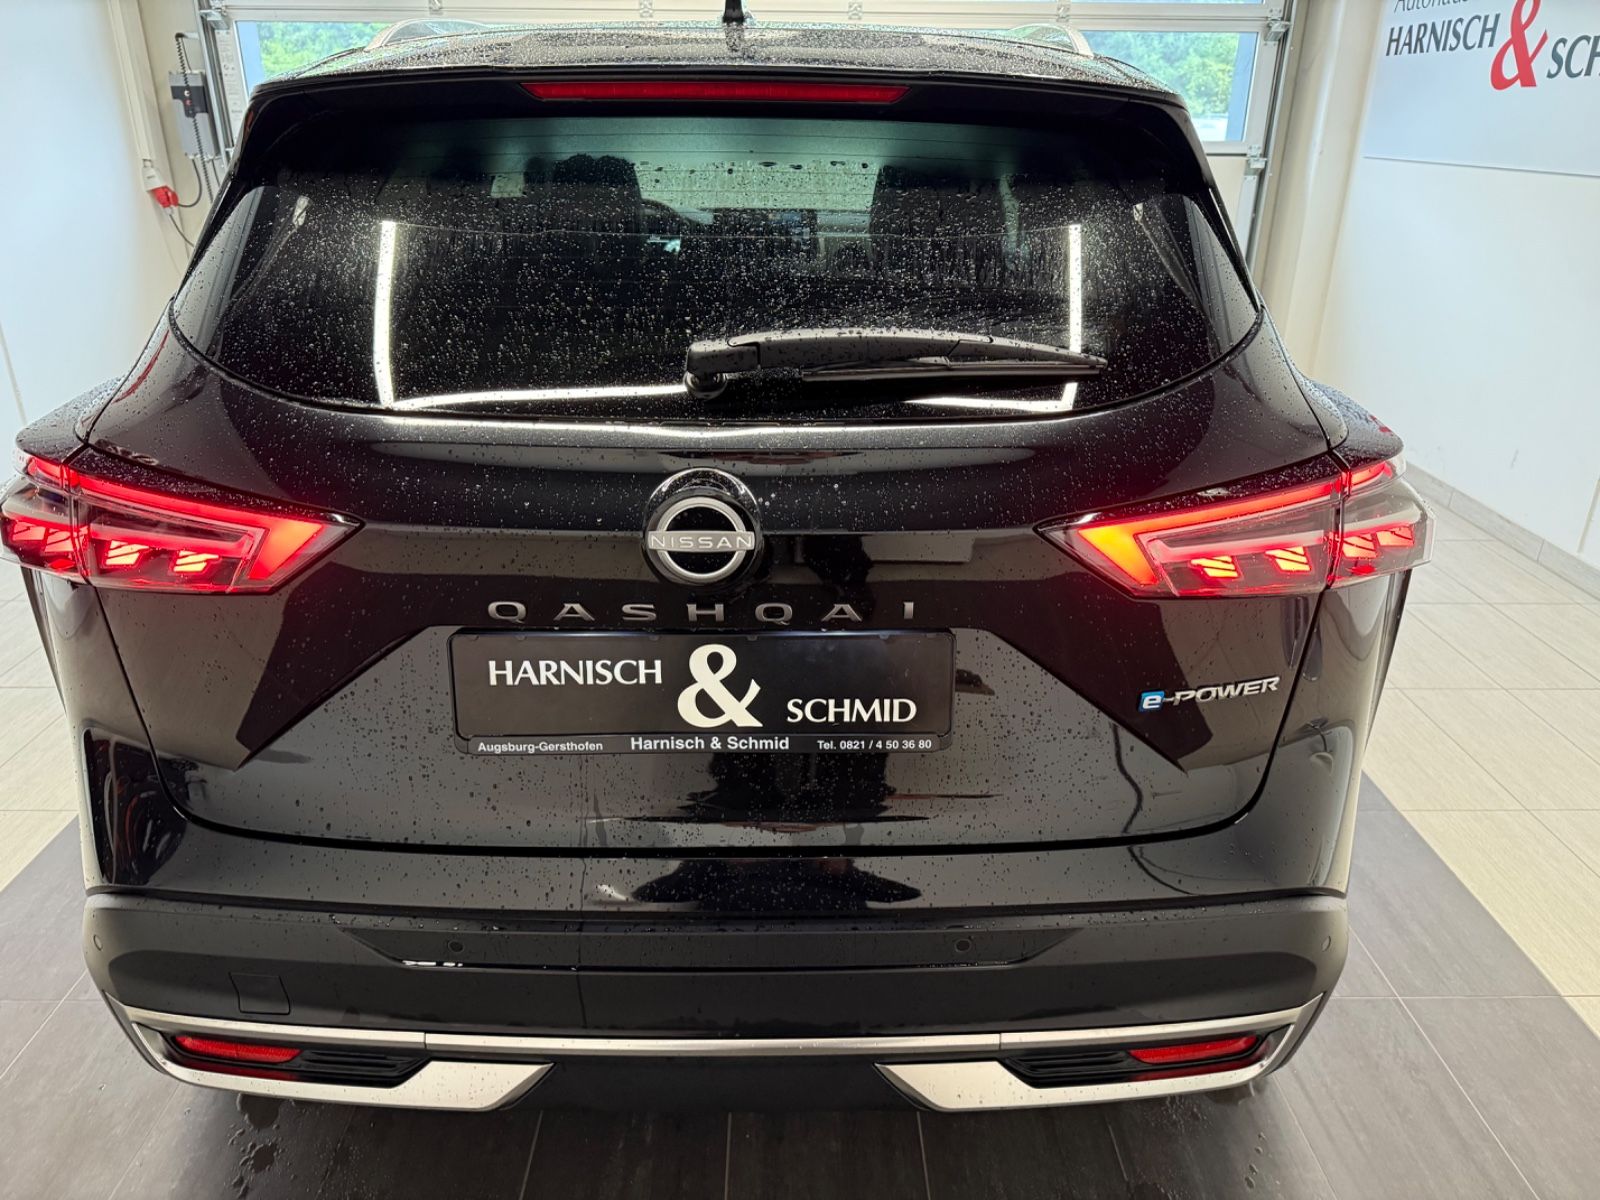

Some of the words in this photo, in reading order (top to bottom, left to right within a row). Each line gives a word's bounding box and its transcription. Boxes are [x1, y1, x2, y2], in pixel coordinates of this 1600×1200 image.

[1385, 13, 1501, 56] HARNISCH
[1490, 0, 1548, 90] &
[650, 536, 752, 549] NISSAN
[487, 601, 914, 625] QASHQAI
[488, 659, 663, 686] HARNISCH
[677, 643, 764, 728] &
[786, 698, 917, 723] SCHMID
[1141, 676, 1280, 710] e-POWER
[477, 740, 604, 755] Augsburg-Gersthofen
[630, 736, 706, 750] Harnisch
[709, 737, 722, 750] &
[727, 736, 790, 750] Schmid
[816, 740, 837, 750] Tel.
[839, 740, 866, 750] 0821
[875, 740, 883, 750] 4
[885, 740, 900, 750] 50
[901, 739, 916, 750] 36
[917, 739, 933, 749] 80
